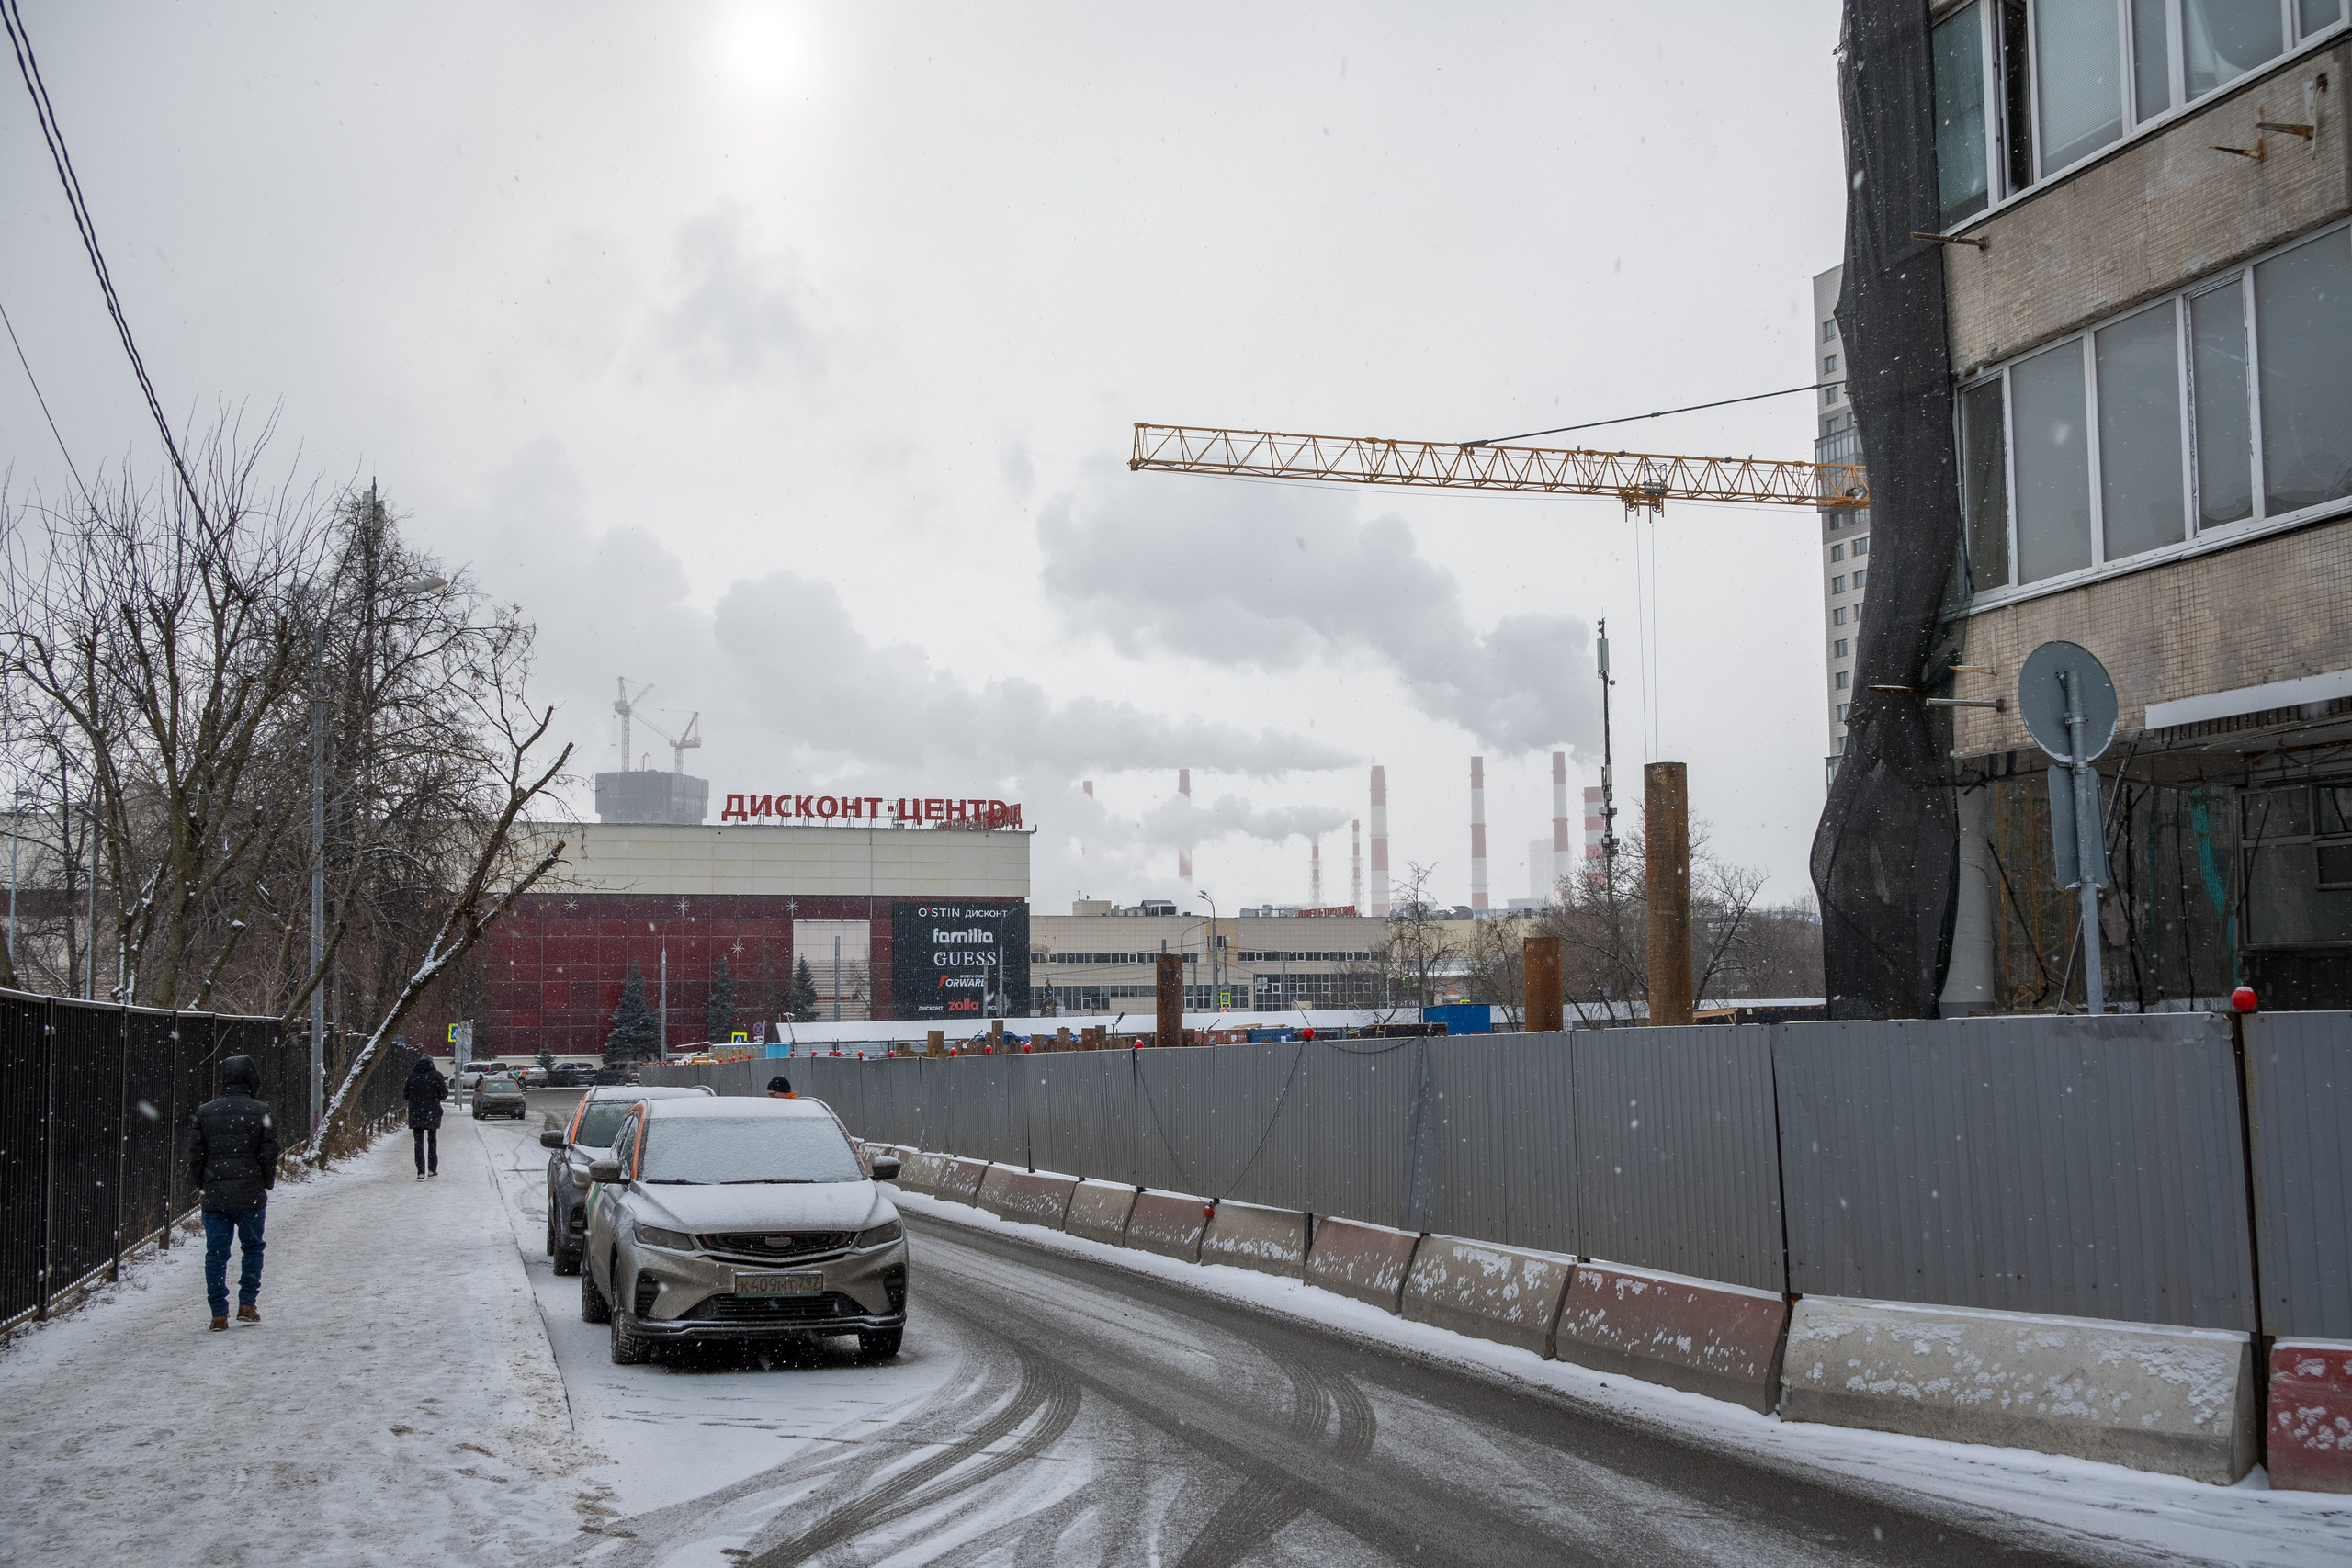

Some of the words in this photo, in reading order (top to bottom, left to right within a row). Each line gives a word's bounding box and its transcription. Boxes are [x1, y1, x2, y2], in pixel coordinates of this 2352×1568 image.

[918, 907, 960, 918] O'STIN
[933, 928, 993, 943] familia
[934, 952, 997, 965] GUESS
[948, 998, 979, 1010] zolla
